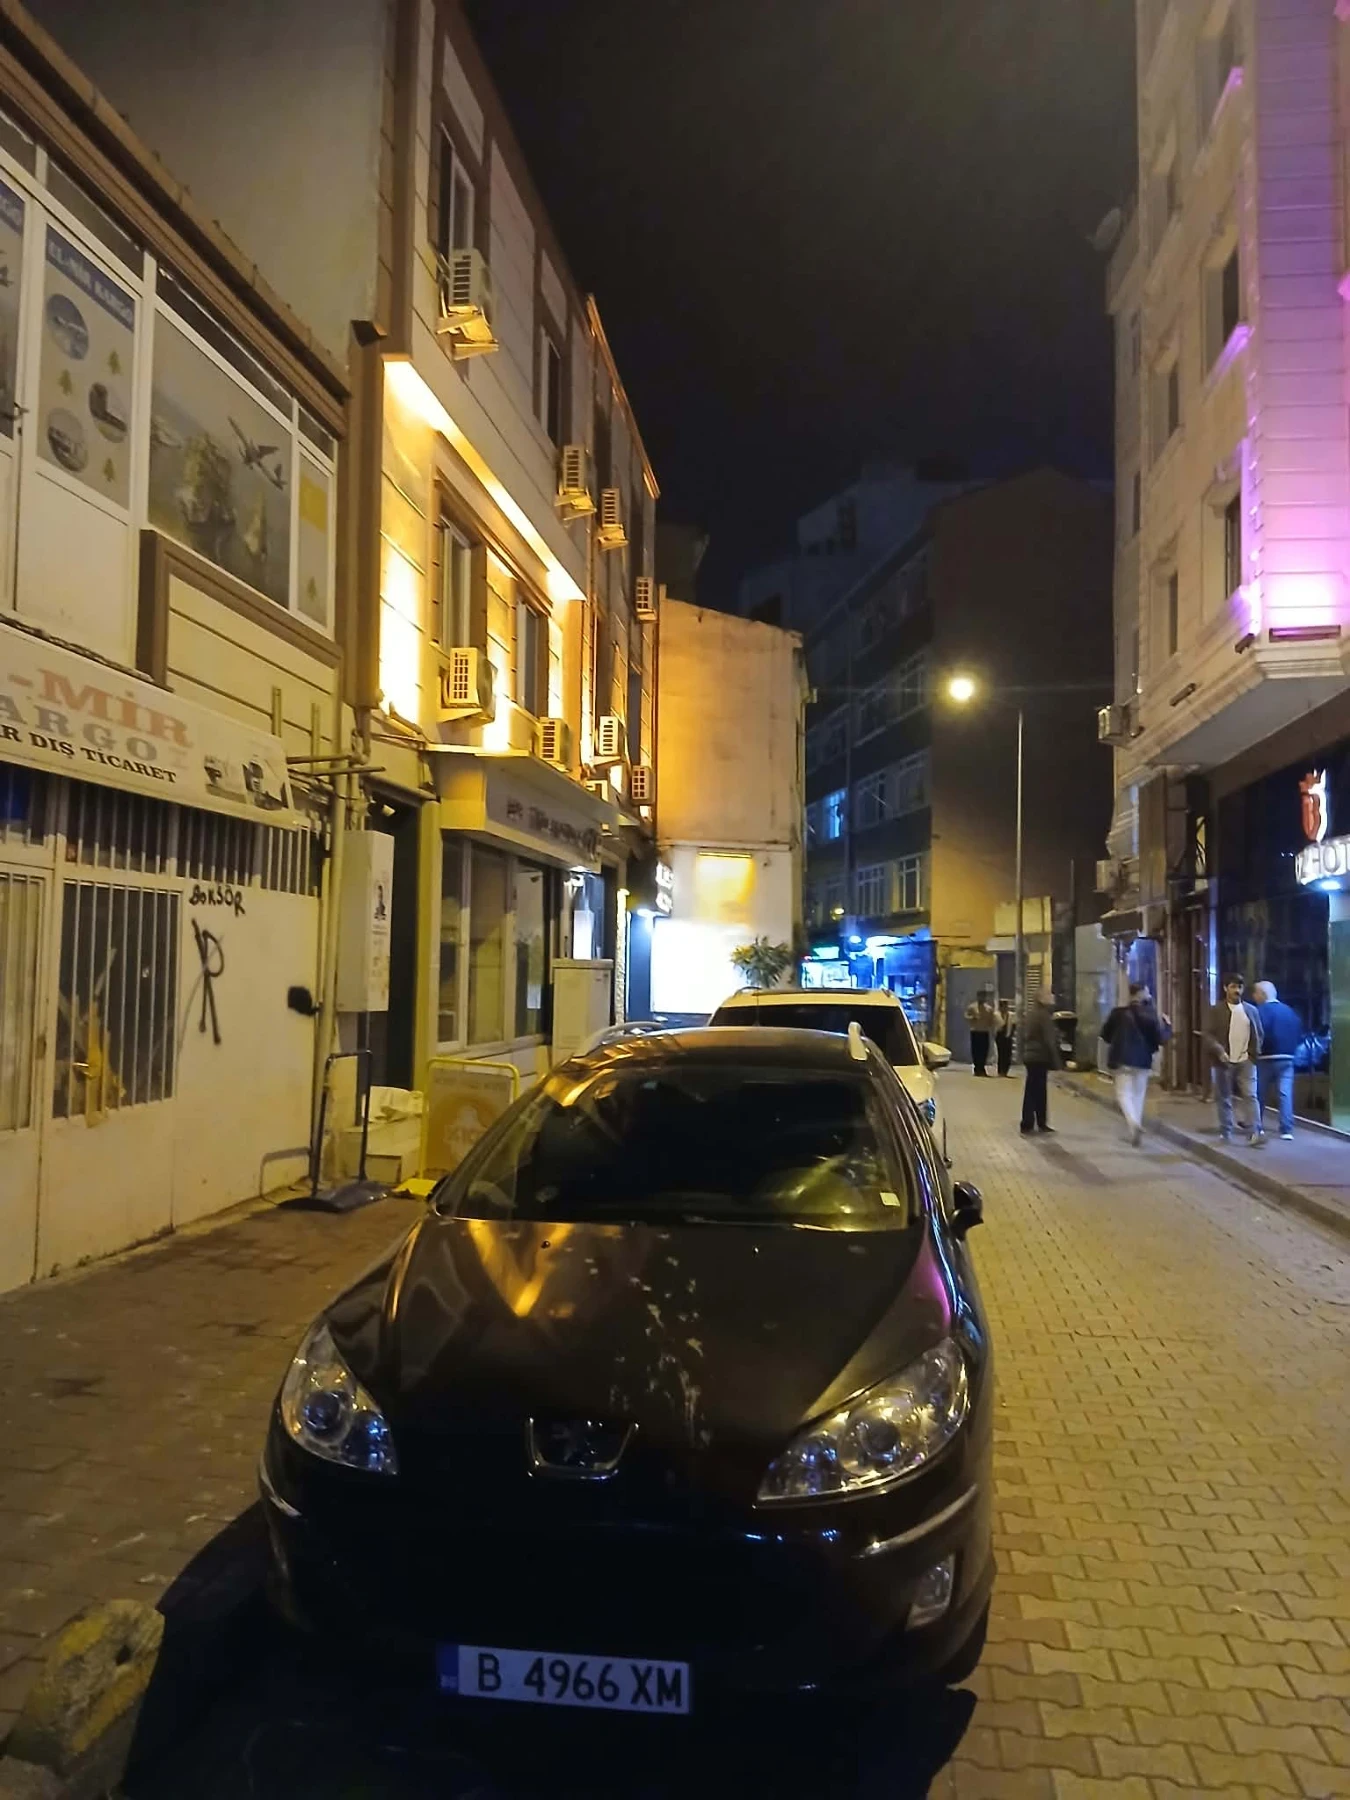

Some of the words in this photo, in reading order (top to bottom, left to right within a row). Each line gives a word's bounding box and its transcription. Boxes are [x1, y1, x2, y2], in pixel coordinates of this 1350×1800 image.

[29, 732, 76, 759] DIŞ
[80, 747, 177, 783] TİCARET
[477, 1652, 502, 1692] B
[524, 1657, 619, 1702] 4966
[630, 1662, 682, 1707] XM
